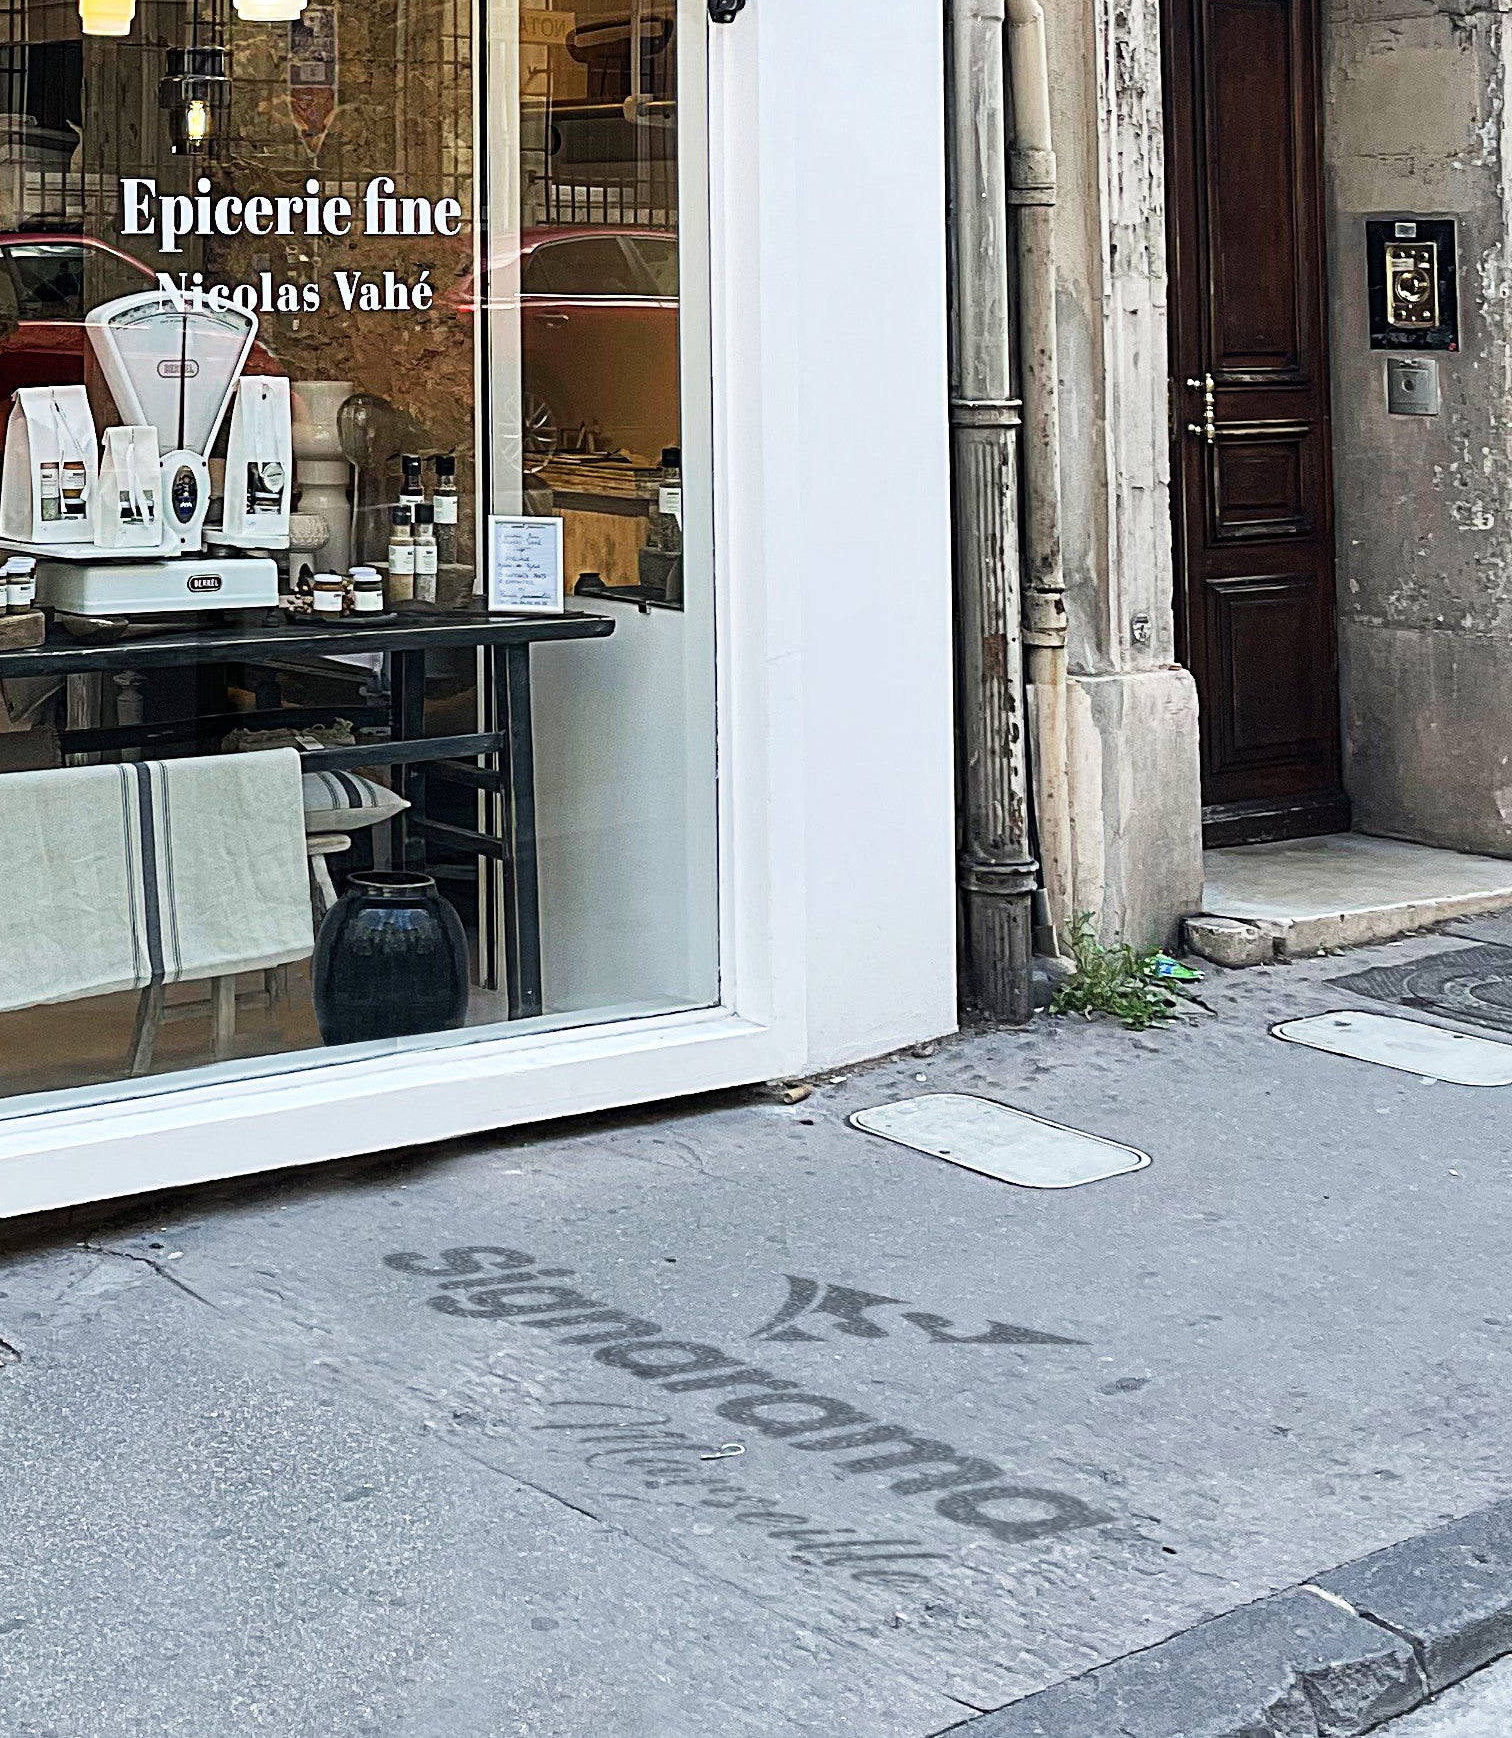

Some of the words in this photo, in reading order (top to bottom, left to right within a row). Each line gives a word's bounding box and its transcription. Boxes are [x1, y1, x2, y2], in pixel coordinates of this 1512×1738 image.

[119, 176, 353, 254] Epicerie
[364, 176, 463, 238] fine
[155, 271, 321, 314] Nicolas
[334, 270, 434, 313] Vahé
